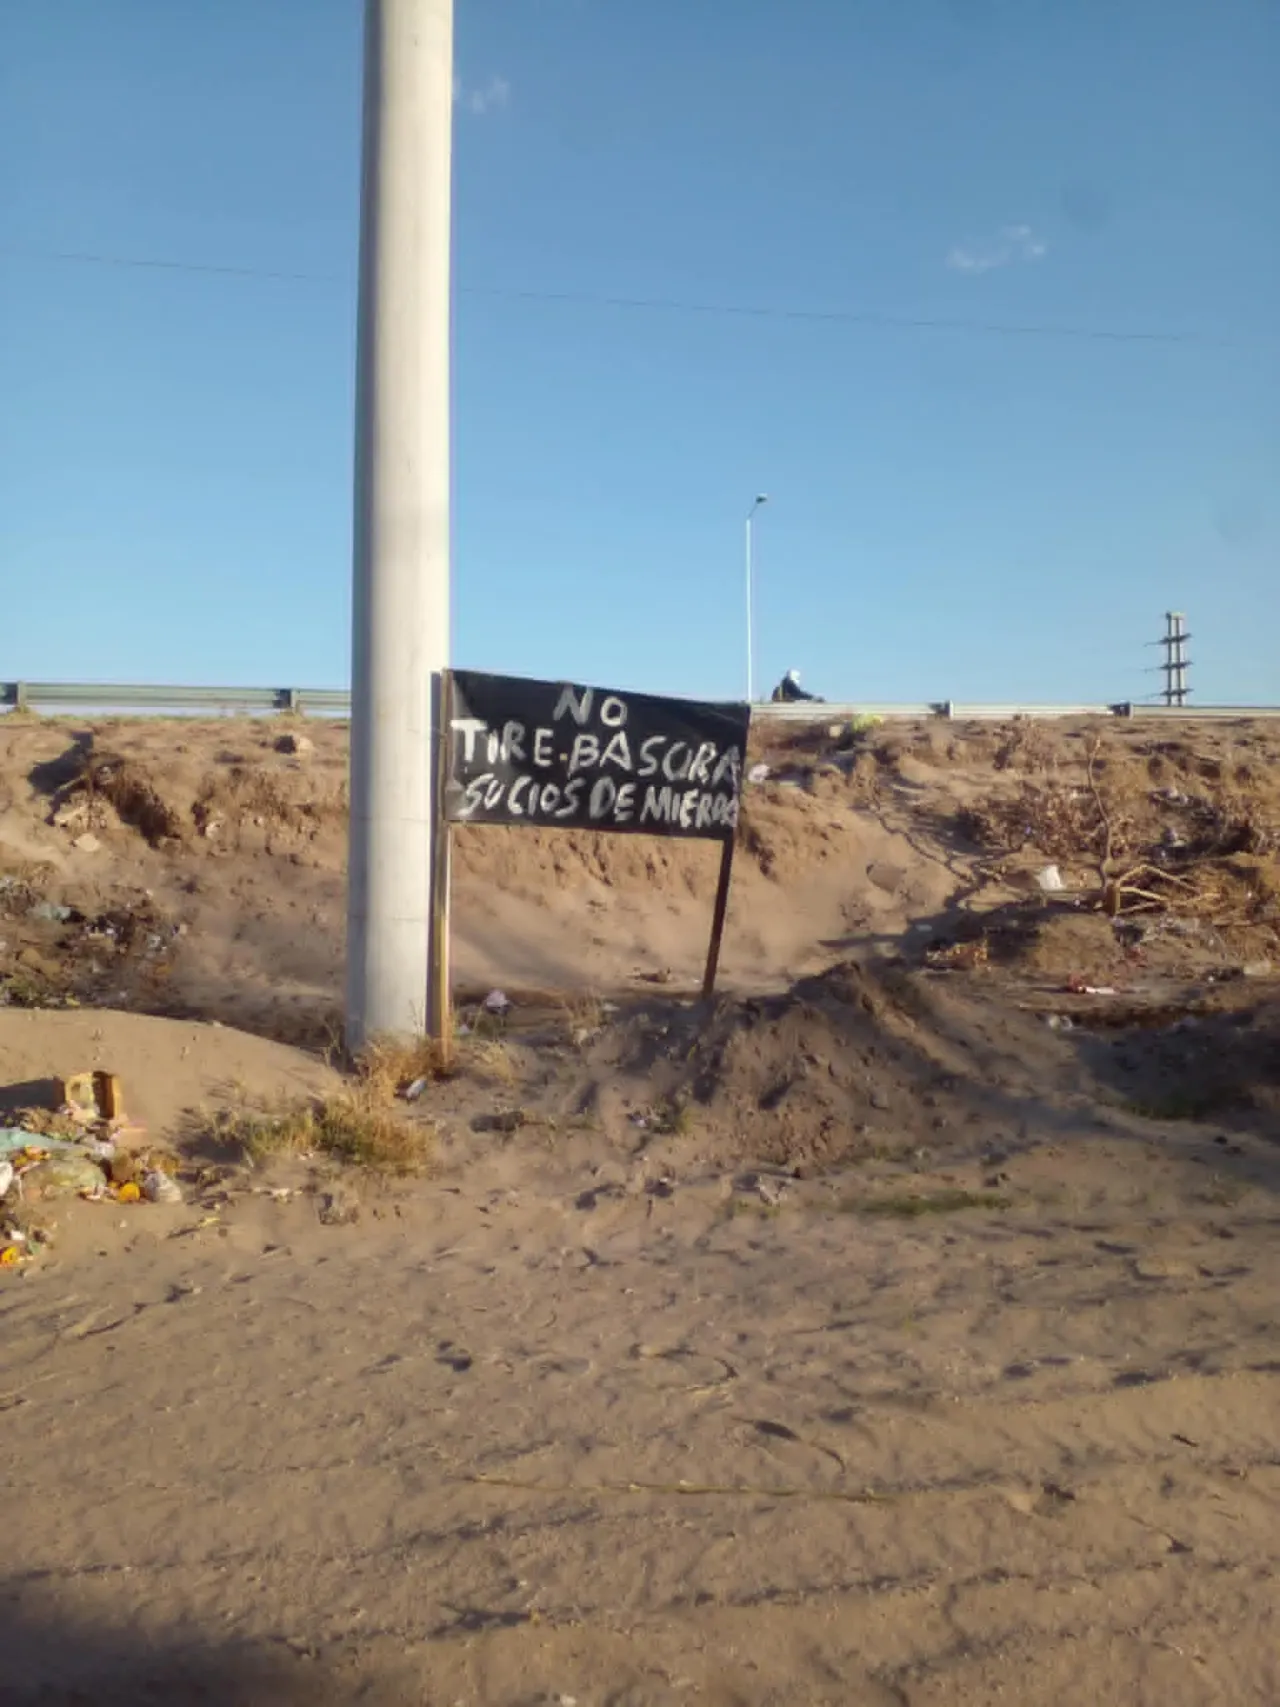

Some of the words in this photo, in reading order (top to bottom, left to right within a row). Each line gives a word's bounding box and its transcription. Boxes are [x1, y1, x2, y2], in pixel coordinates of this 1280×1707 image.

[553, 682, 628, 726] NO
[450, 718, 555, 767] TIRE
[567, 730, 741, 787] BASURA
[456, 772, 586, 817] SUCIOS
[590, 776, 637, 822] DE
